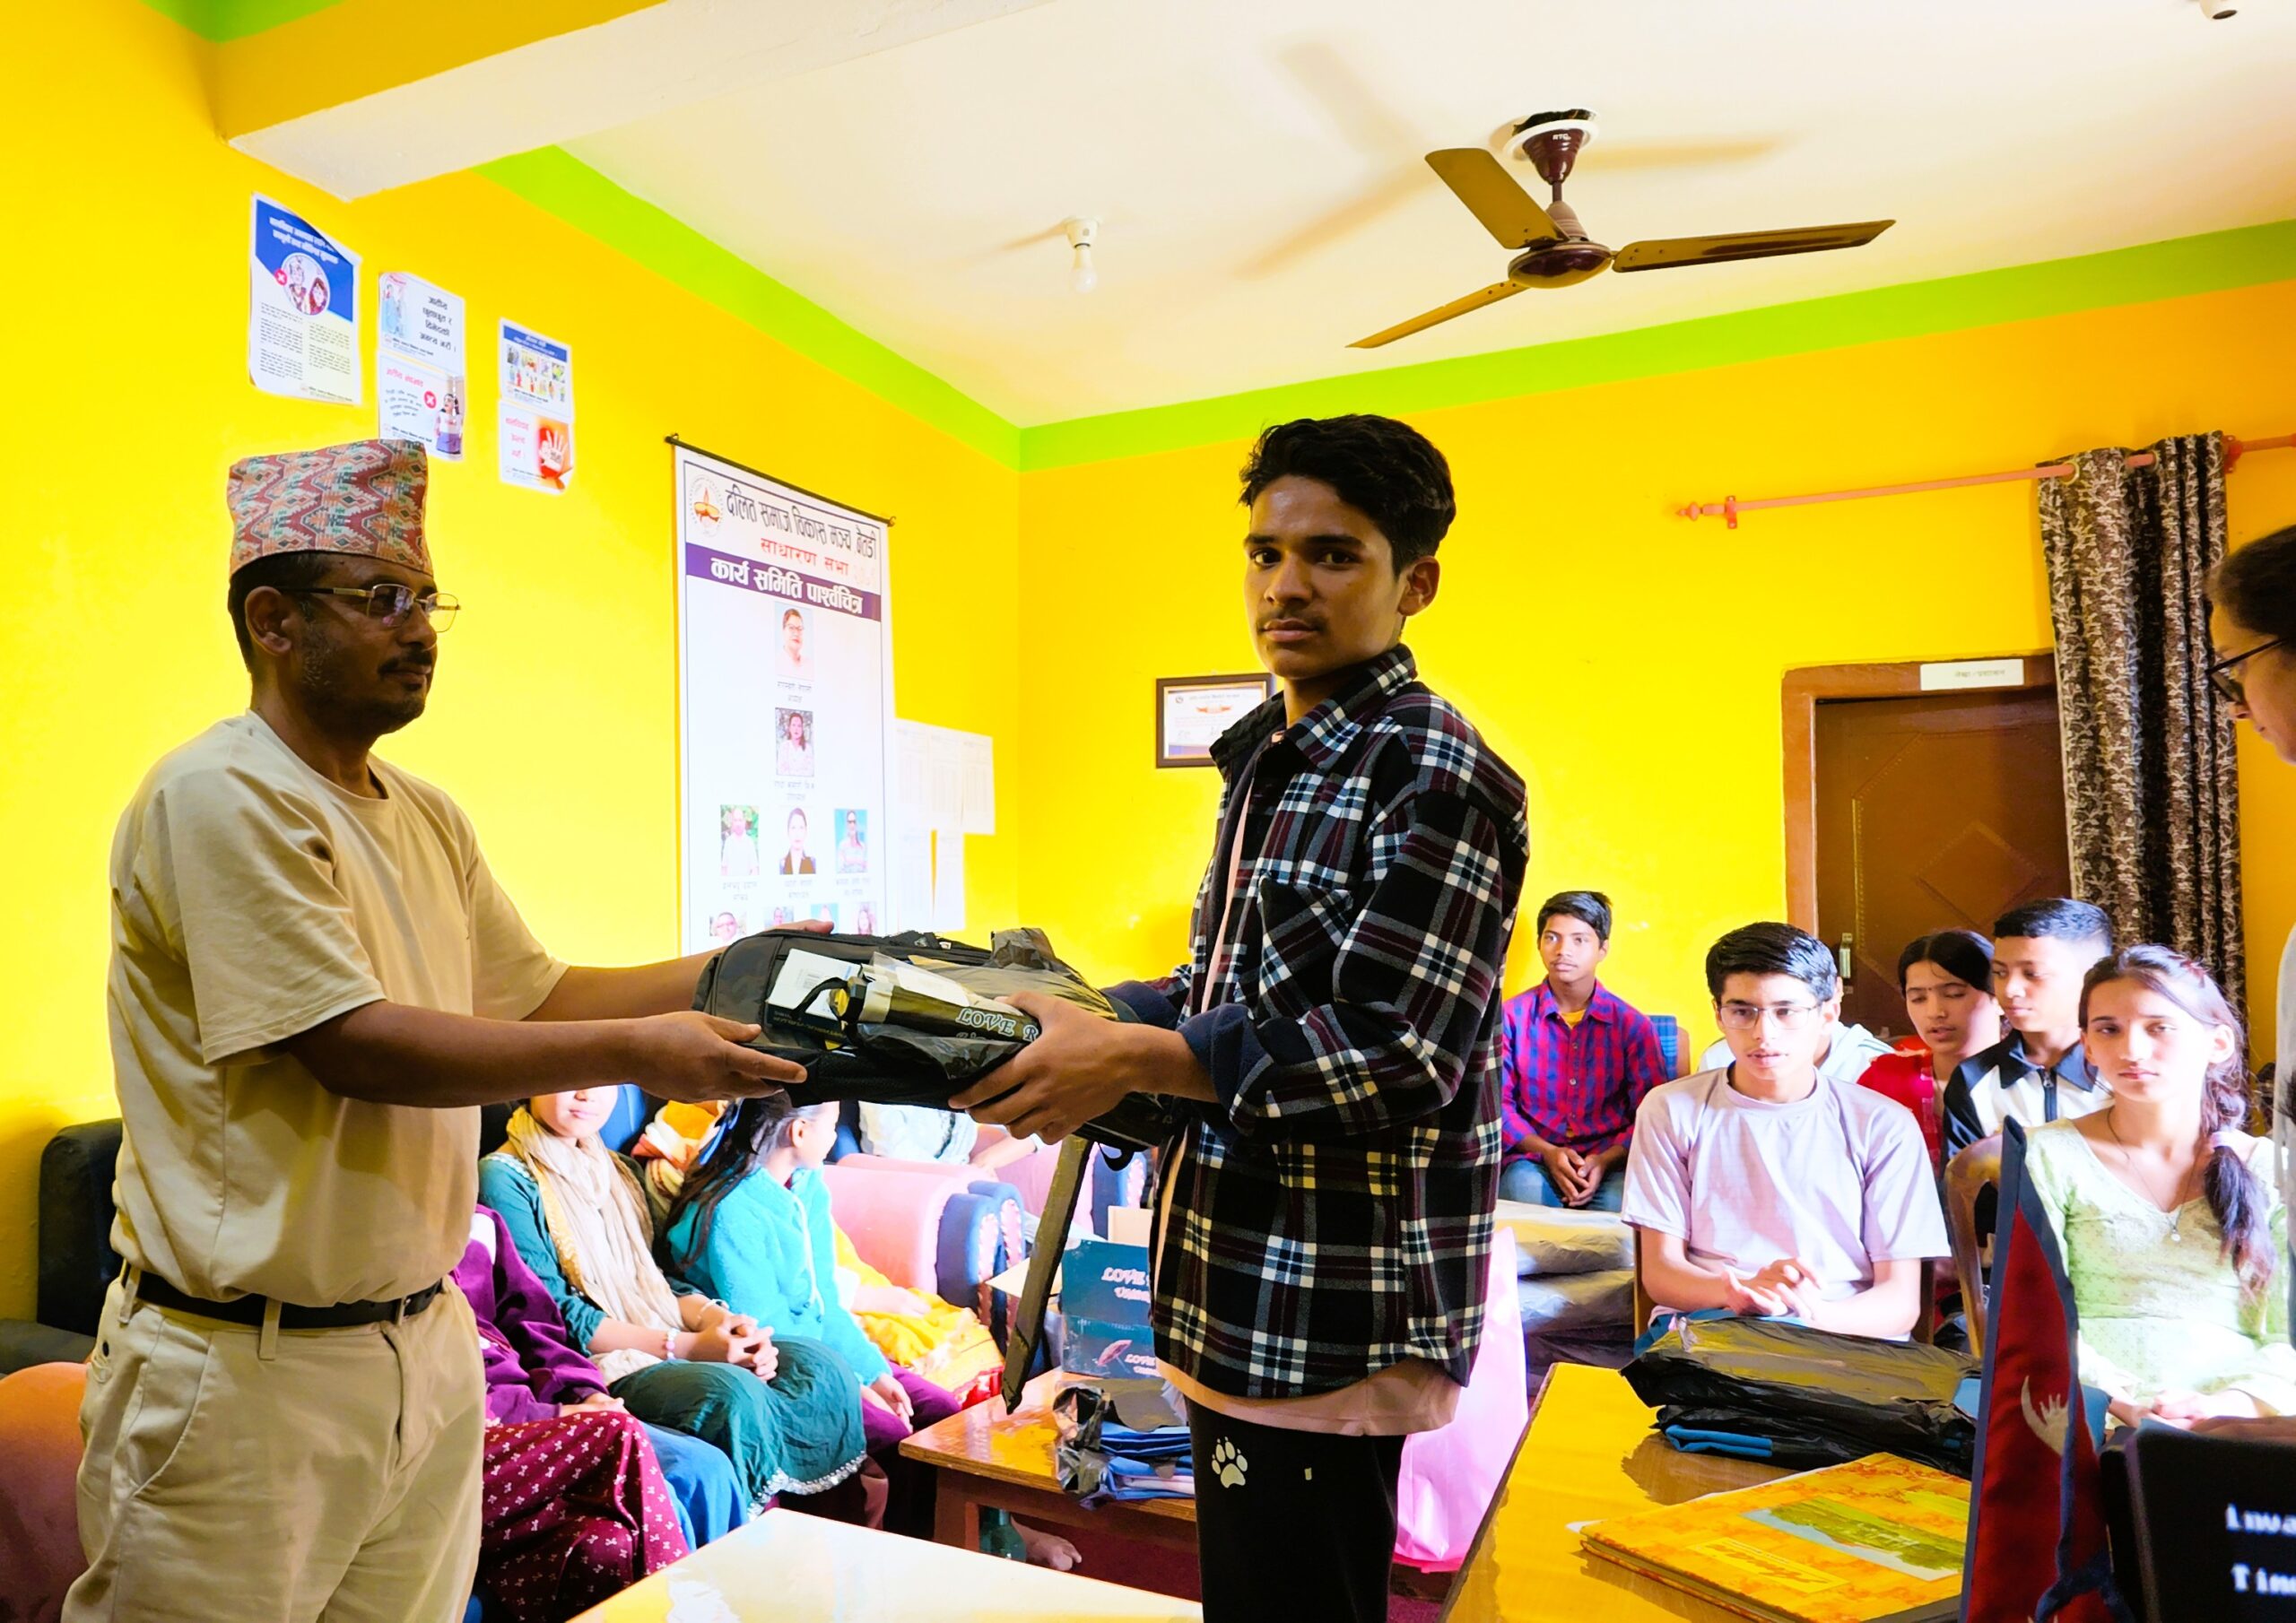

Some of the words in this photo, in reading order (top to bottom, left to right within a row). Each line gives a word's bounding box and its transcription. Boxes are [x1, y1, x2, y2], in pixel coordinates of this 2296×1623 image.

[725, 483, 757, 522] दलित
[759, 501, 792, 534] समाज
[792, 505, 827, 545] विकास
[828, 525, 851, 551] मञ्च
[761, 538, 817, 567] साधारण
[823, 556, 849, 576] सभा
[710, 557, 750, 586] कार्य
[753, 566, 803, 599] समिति
[955, 1008, 1016, 1037] LOVE
[1100, 1267, 1146, 1286] LOVE
